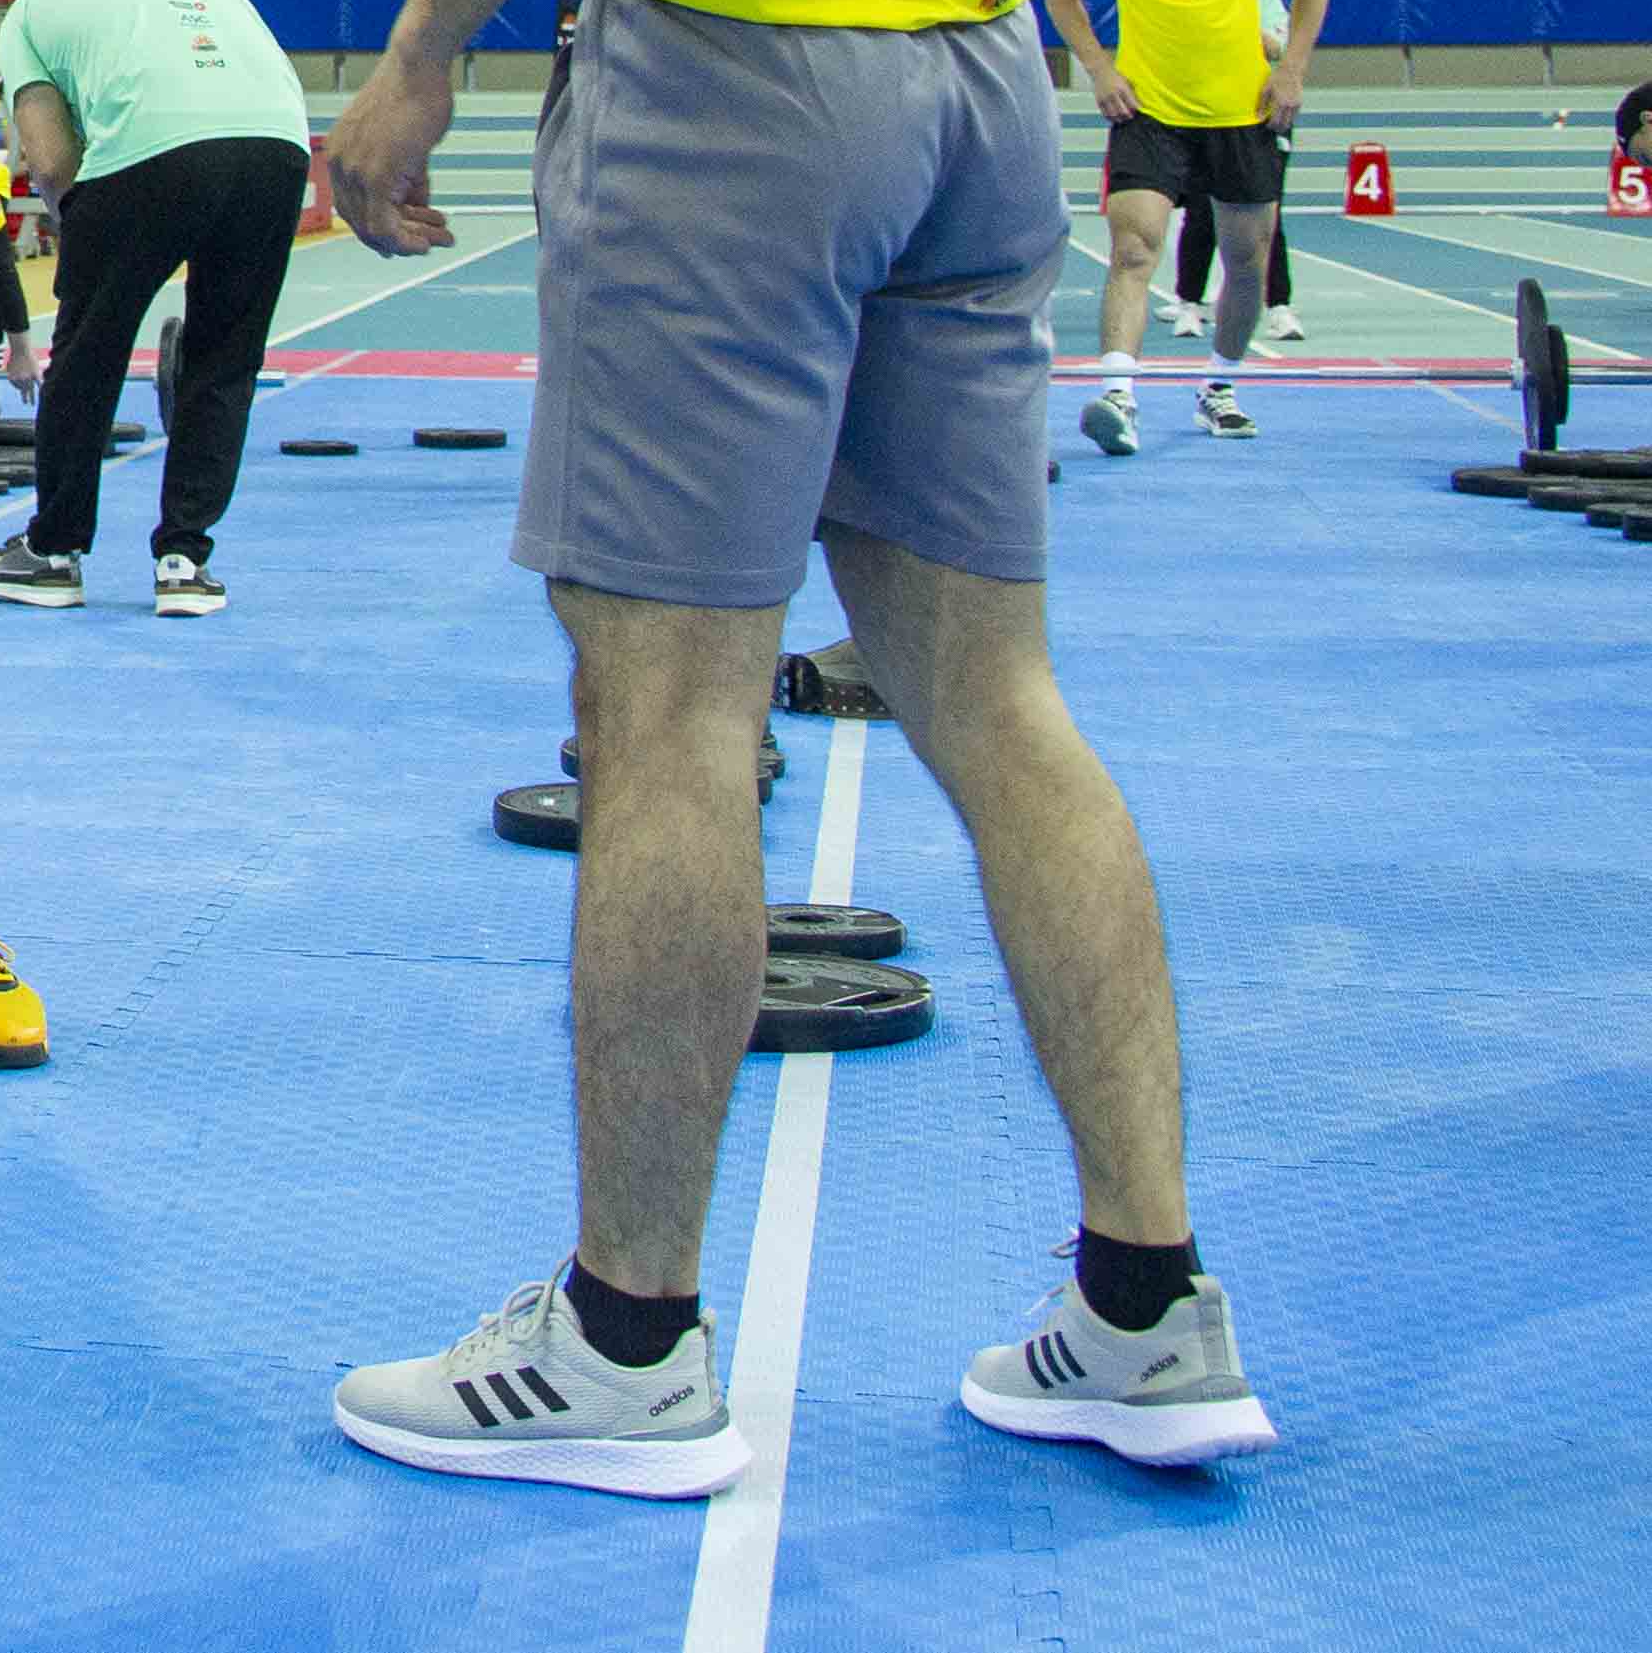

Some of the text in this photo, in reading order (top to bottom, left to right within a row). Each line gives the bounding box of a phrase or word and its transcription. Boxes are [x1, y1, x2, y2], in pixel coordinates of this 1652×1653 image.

[1353, 164, 1383, 202] 4
[1618, 166, 1649, 205] 5
[648, 1385, 695, 1417] adidas
